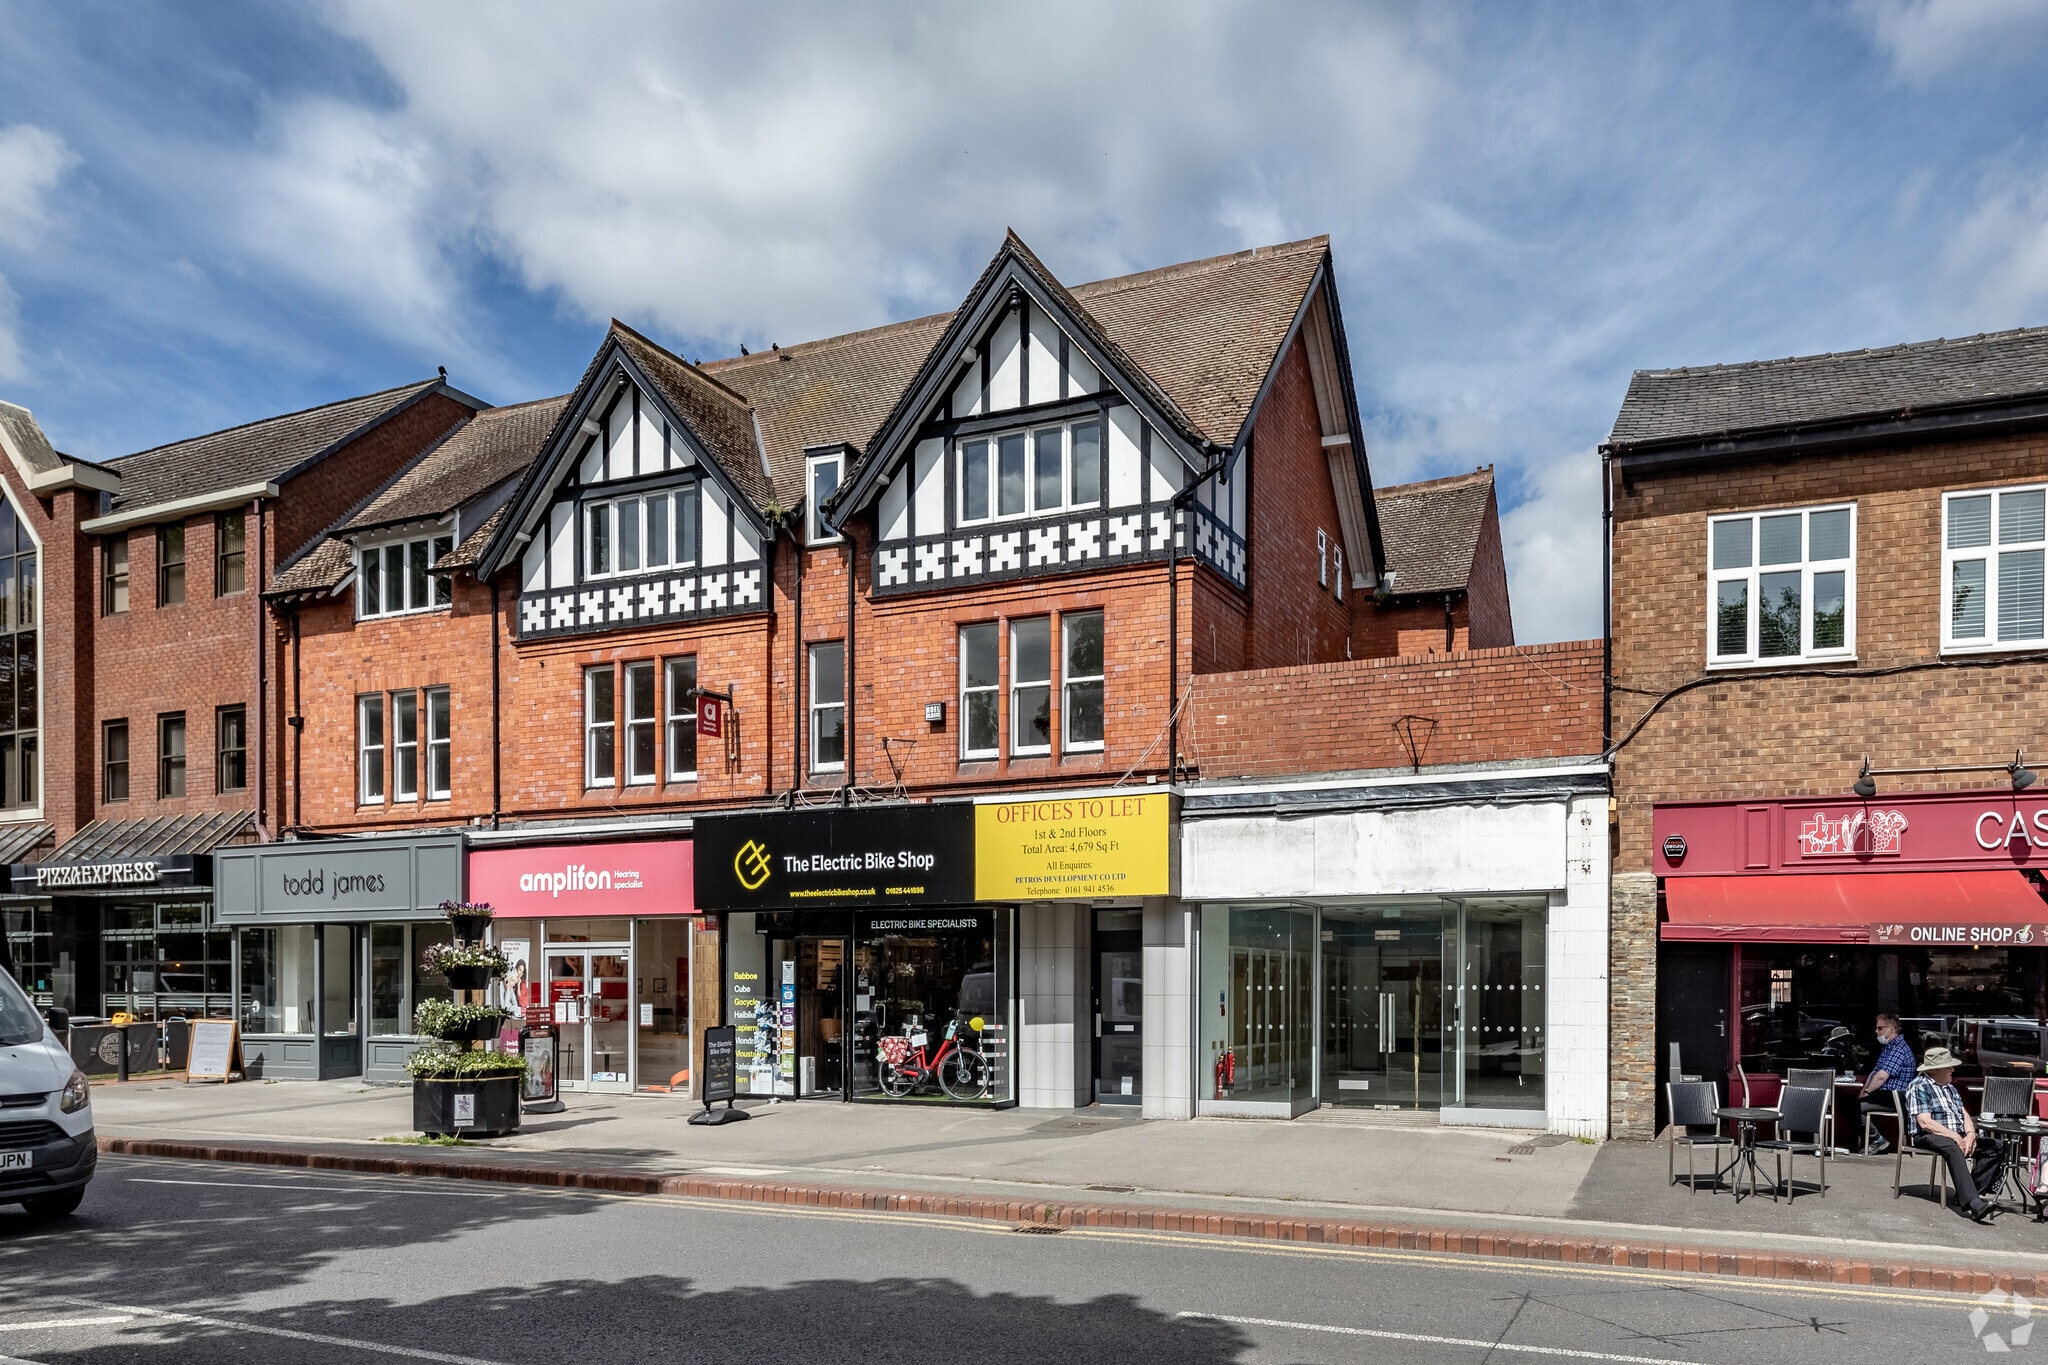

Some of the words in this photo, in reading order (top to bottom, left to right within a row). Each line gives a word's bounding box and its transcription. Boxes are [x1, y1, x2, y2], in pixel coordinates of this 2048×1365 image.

[996, 802, 1073, 824] OFFICES
[1078, 800, 1104, 819] TO
[1109, 798, 1146, 817] LET
[1034, 829, 1046, 840] 1st
[1048, 828, 1057, 839] &
[1059, 827, 1076, 839] 2nd
[1078, 826, 1107, 838] Floors
[1021, 844, 1043, 855] Total
[1044, 843, 1067, 854] Area:
[1096, 841, 1108, 854] Sq
[1110, 840, 1119, 851] Ft
[783, 856, 809, 873] The
[811, 853, 863, 871] Electric
[865, 852, 896, 870] Bike
[897, 851, 935, 871] Shop
[1046, 861, 1057, 871] All
[1059, 860, 1094, 872] Enquires:
[36, 861, 156, 887] PIZZAEXPRESS
[613, 869, 640, 880] Hearing
[1015, 876, 1043, 884] PETROS
[1043, 874, 1098, 883] DEVELOPMENT
[1099, 873, 1111, 881] CO
[283, 867, 324, 896] todd
[331, 871, 385, 900] james
[519, 863, 611, 898] amplifon
[613, 880, 643, 891] specialist
[789, 887, 876, 898] www.theelectricbikeshop.co.uk
[1026, 886, 1061, 896] Telephone:
[1065, 885, 1081, 894] 0161
[1083, 885, 1095, 893] 941
[1097, 884, 1115, 893] 4536
[870, 920, 908, 929] ELECTRIC
[908, 919, 927, 929] BIKE
[927, 918, 978, 928] SPECIALISTS
[1910, 926, 1966, 942] ONLINE
[1969, 927, 2013, 942] SHOP
[733, 971, 758, 980] Babboe
[733, 985, 751, 993] Cube
